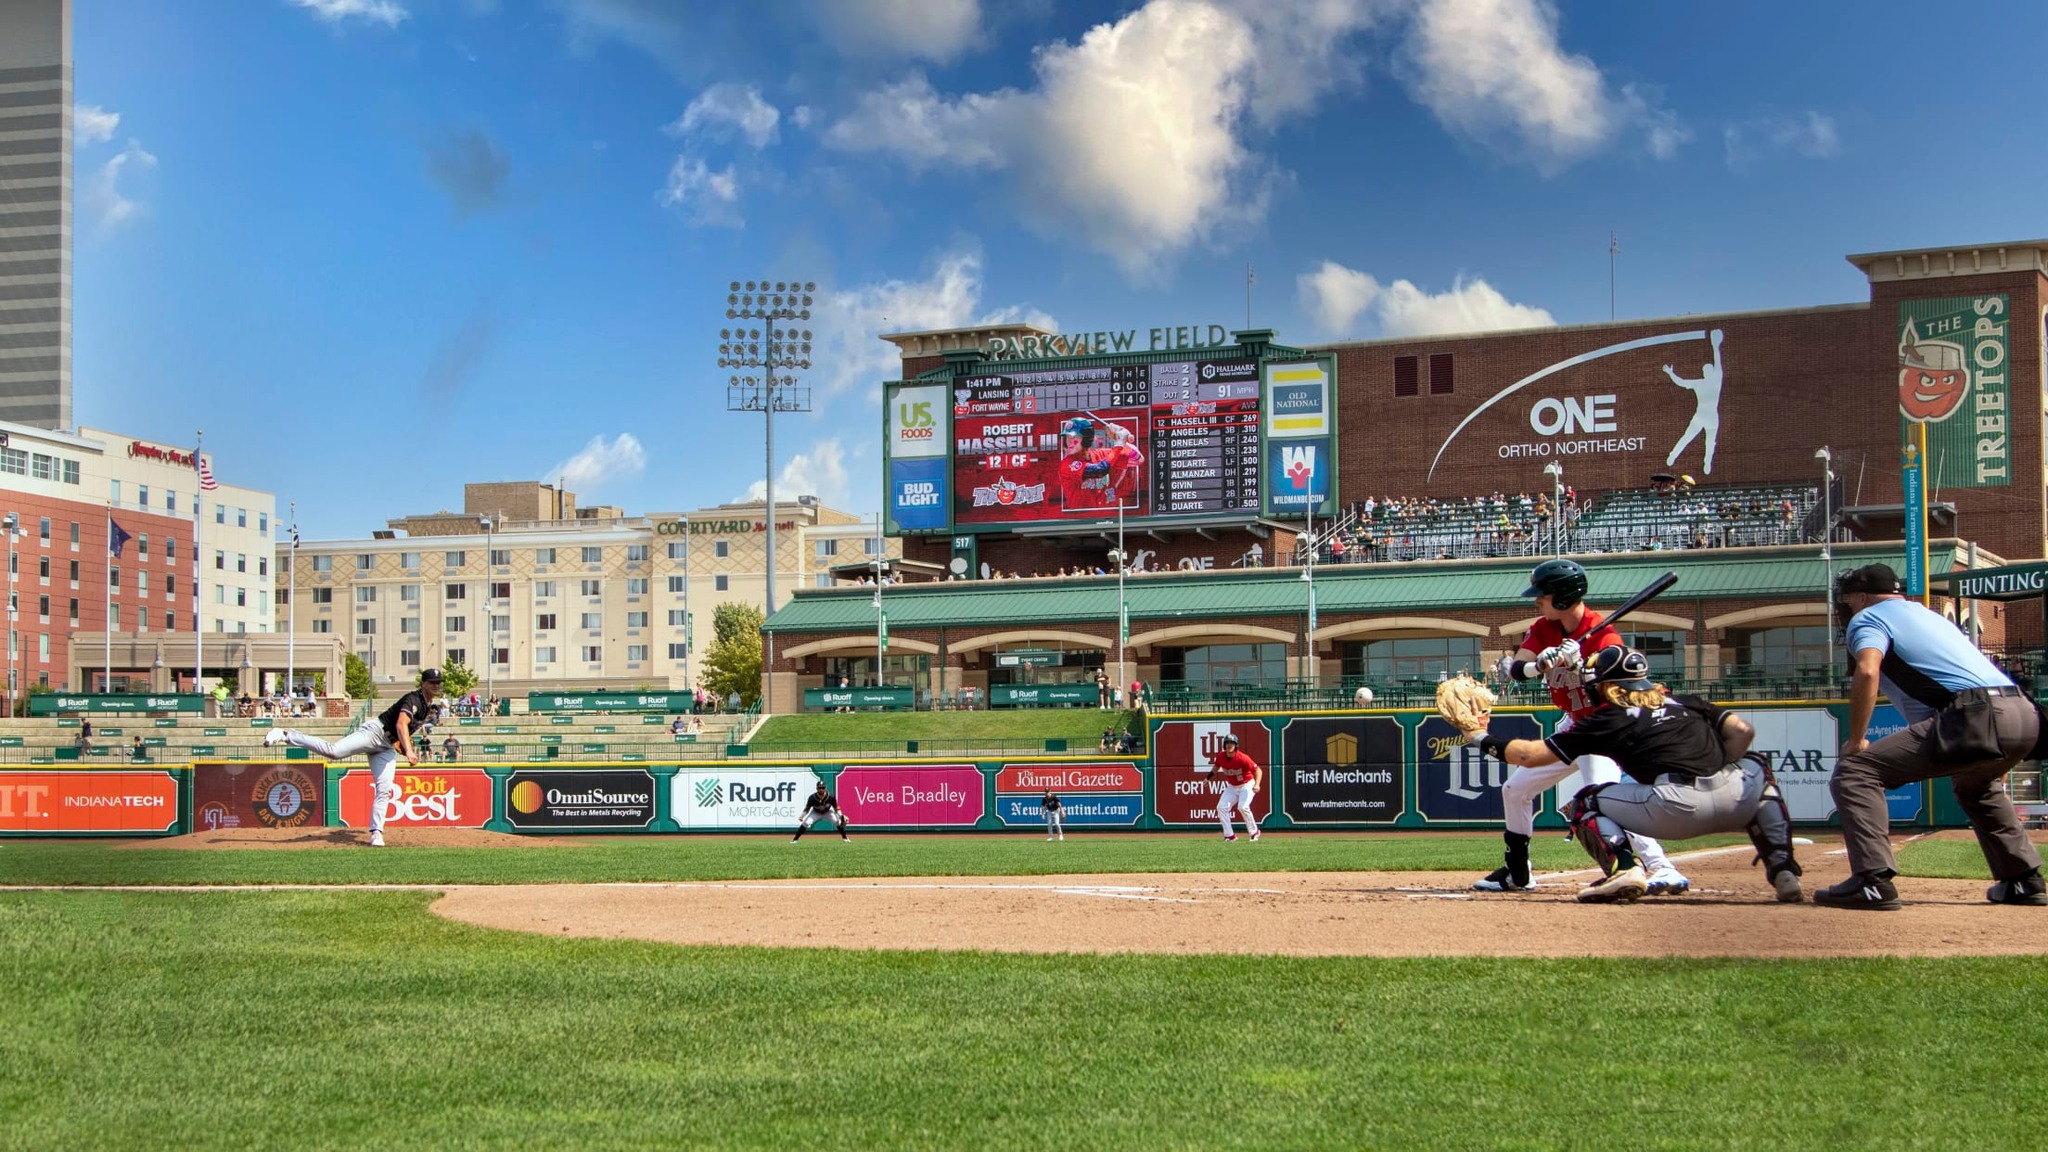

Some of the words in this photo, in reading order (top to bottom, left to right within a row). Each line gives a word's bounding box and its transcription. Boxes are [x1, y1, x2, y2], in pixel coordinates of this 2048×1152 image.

[1926, 316, 1962, 336] THE
[988, 329, 1136, 361] PARKVIEW
[1149, 324, 1227, 351] FIELD
[1160, 366, 1178, 374] BALL
[1182, 364, 1189, 374] 2
[1216, 364, 1256, 373] HALLMARK
[966, 379, 984, 388] 1:41
[985, 378, 1002, 387] PM
[1113, 382, 1120, 392] 0
[1126, 382, 1132, 390] 0
[1140, 381, 1146, 390] 0
[1153, 379, 1178, 387] STRIKE
[1182, 377, 1190, 386] 2
[978, 389, 1010, 400] LANSING
[1015, 388, 1021, 396] 0
[1026, 387, 1032, 395] 0
[1163, 392, 1178, 400] OUT
[1182, 389, 1190, 399] 2
[1218, 385, 1231, 398] 91
[1236, 386, 1254, 394] MPH
[1288, 392, 1307, 400] OLD
[1974, 297, 2006, 483] TREETOPS
[972, 403, 987, 412] FORT
[988, 402, 1010, 412] WAYNE
[1015, 402, 1021, 410] 0
[1026, 400, 1032, 409] 2
[1113, 396, 1120, 405] 2
[1126, 395, 1133, 404] 4
[1140, 394, 1146, 402] 0
[1240, 402, 1256, 410] AVG
[1276, 399, 1319, 408] NATIONAL
[1170, 418, 1208, 426] HASSELL
[1241, 414, 1257, 422] .269
[1530, 394, 1617, 436] ONE
[901, 428, 933, 439] FOODS
[983, 424, 1034, 436] ROBERT
[1170, 428, 1208, 436] ANGELES
[1242, 424, 1256, 433] .310
[958, 436, 1038, 456] HASSELL
[1040, 434, 1058, 451] III
[1170, 438, 1209, 447] ORNELAS
[1241, 436, 1258, 444] .240
[1498, 442, 1551, 458] ORTHO
[1556, 437, 1646, 455] NORTHEAST
[1171, 450, 1197, 458] LOPEZ
[1241, 446, 1258, 454] .238
[989, 456, 1002, 468] 12
[1012, 454, 1027, 467] CF
[1171, 459, 1208, 468] SOLARTE
[1241, 456, 1258, 465] .500
[1170, 470, 1216, 479] ALMANZAR
[1242, 468, 1256, 476] .219
[904, 482, 934, 495] BUD
[1171, 482, 1192, 490] GIVIN
[1242, 478, 1256, 486] .199
[1909, 469, 1918, 504] Indiana
[898, 493, 940, 506] LIGHT
[1172, 491, 1197, 500] REYES
[1242, 488, 1256, 496] .176
[1273, 494, 1325, 504] WILDMANBGCOM
[1172, 502, 1204, 510] DUARTE
[1242, 499, 1258, 508] .500
[657, 520, 751, 535] COURTYARD
[955, 538, 969, 548] 517
[1911, 546, 1919, 592] Insurance
[1959, 571, 2048, 596] HUNTING
[68, 698, 90, 706] Ruoff
[157, 698, 178, 706] Ruoff
[1875, 725, 1892, 738] Ayres
[1427, 735, 1471, 758] Mille
[1758, 749, 1828, 772] TAR
[1295, 770, 1319, 784] First
[1322, 770, 1392, 784] Merchants
[1444, 745, 1517, 800] Lit
[404, 776, 432, 794] Do
[434, 776, 448, 794] it
[1015, 771, 1066, 788] Journal
[1069, 771, 1123, 787] Gazette
[1776, 778, 1800, 786] Private
[1802, 778, 1830, 788] Advisory
[729, 782, 796, 802] Ruoff
[1174, 780, 1204, 795] FORT
[64, 796, 122, 807] INDIANA
[123, 796, 164, 807] TECH
[546, 788, 648, 805] OmniSource
[854, 786, 895, 806] Vera
[902, 782, 966, 808] Bradley
[370, 782, 462, 822] Best
[1302, 800, 1386, 808] www.firstmerchants.com
[612, 809, 642, 817] Recycling
[729, 806, 796, 818] MORTGAGE
[1010, 802, 1128, 816] News-entinel.com
[258, 808, 276, 824] DAY
[284, 808, 310, 828] NIGHT
[1863, 886, 1882, 900] N
[2014, 881, 2024, 895] N
